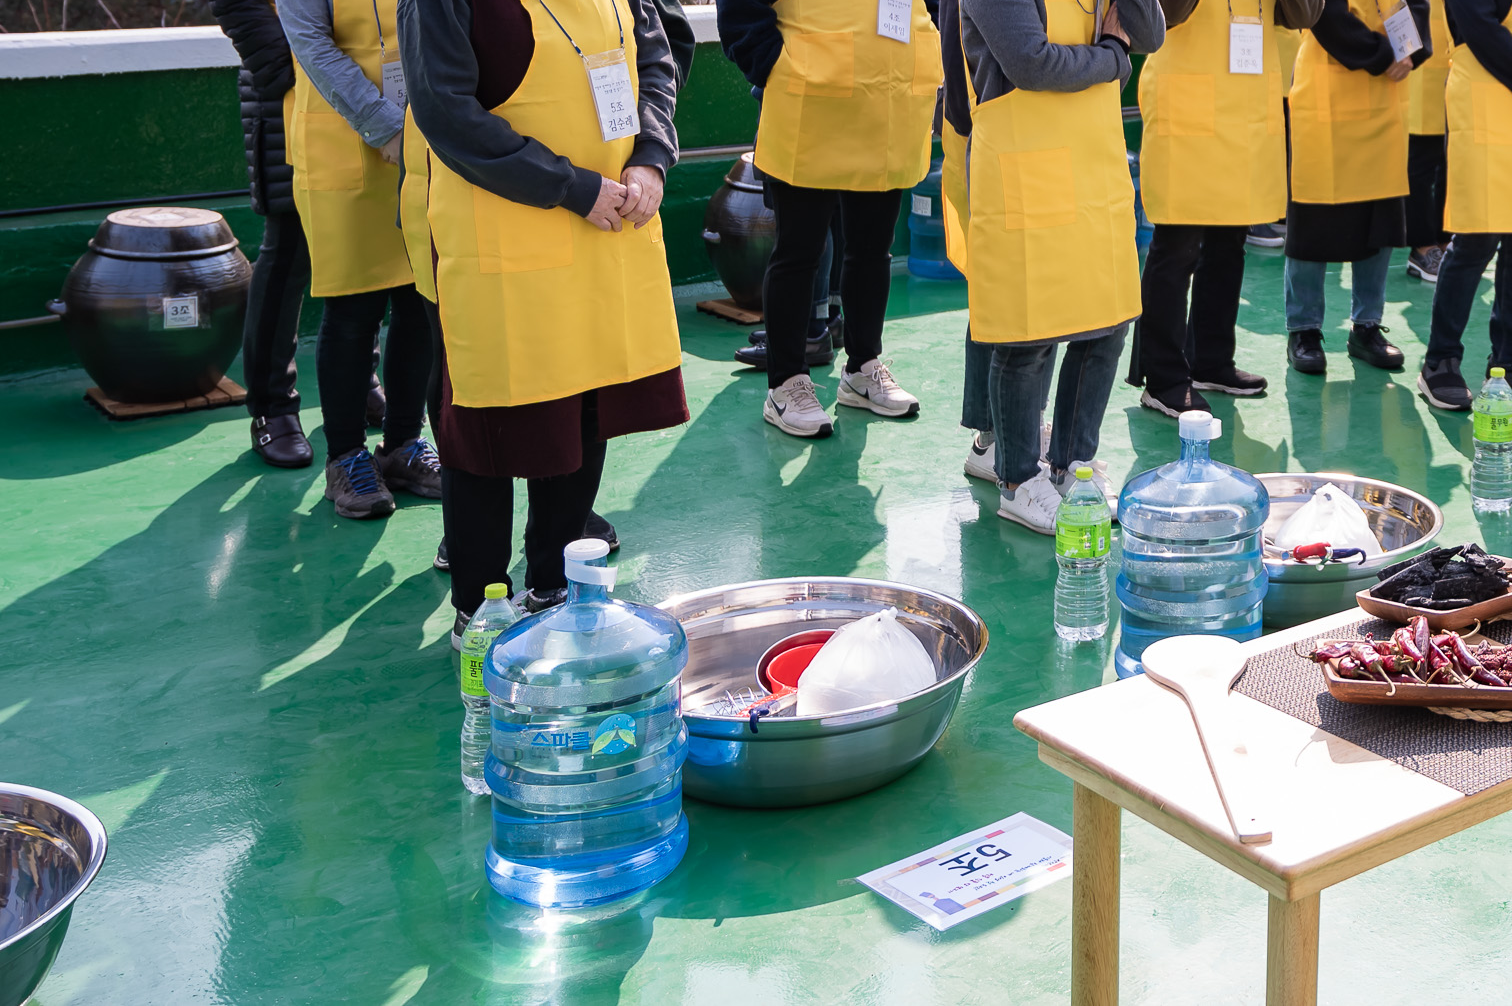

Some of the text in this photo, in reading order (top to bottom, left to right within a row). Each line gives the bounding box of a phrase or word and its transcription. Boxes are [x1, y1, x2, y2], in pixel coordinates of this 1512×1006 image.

[610, 101, 625, 114] 5조
[171, 305, 191, 316] 3조
[1490, 417, 1509, 431] 풀무원
[530, 731, 592, 751] 스파클
[938, 843, 1013, 877] 5조
